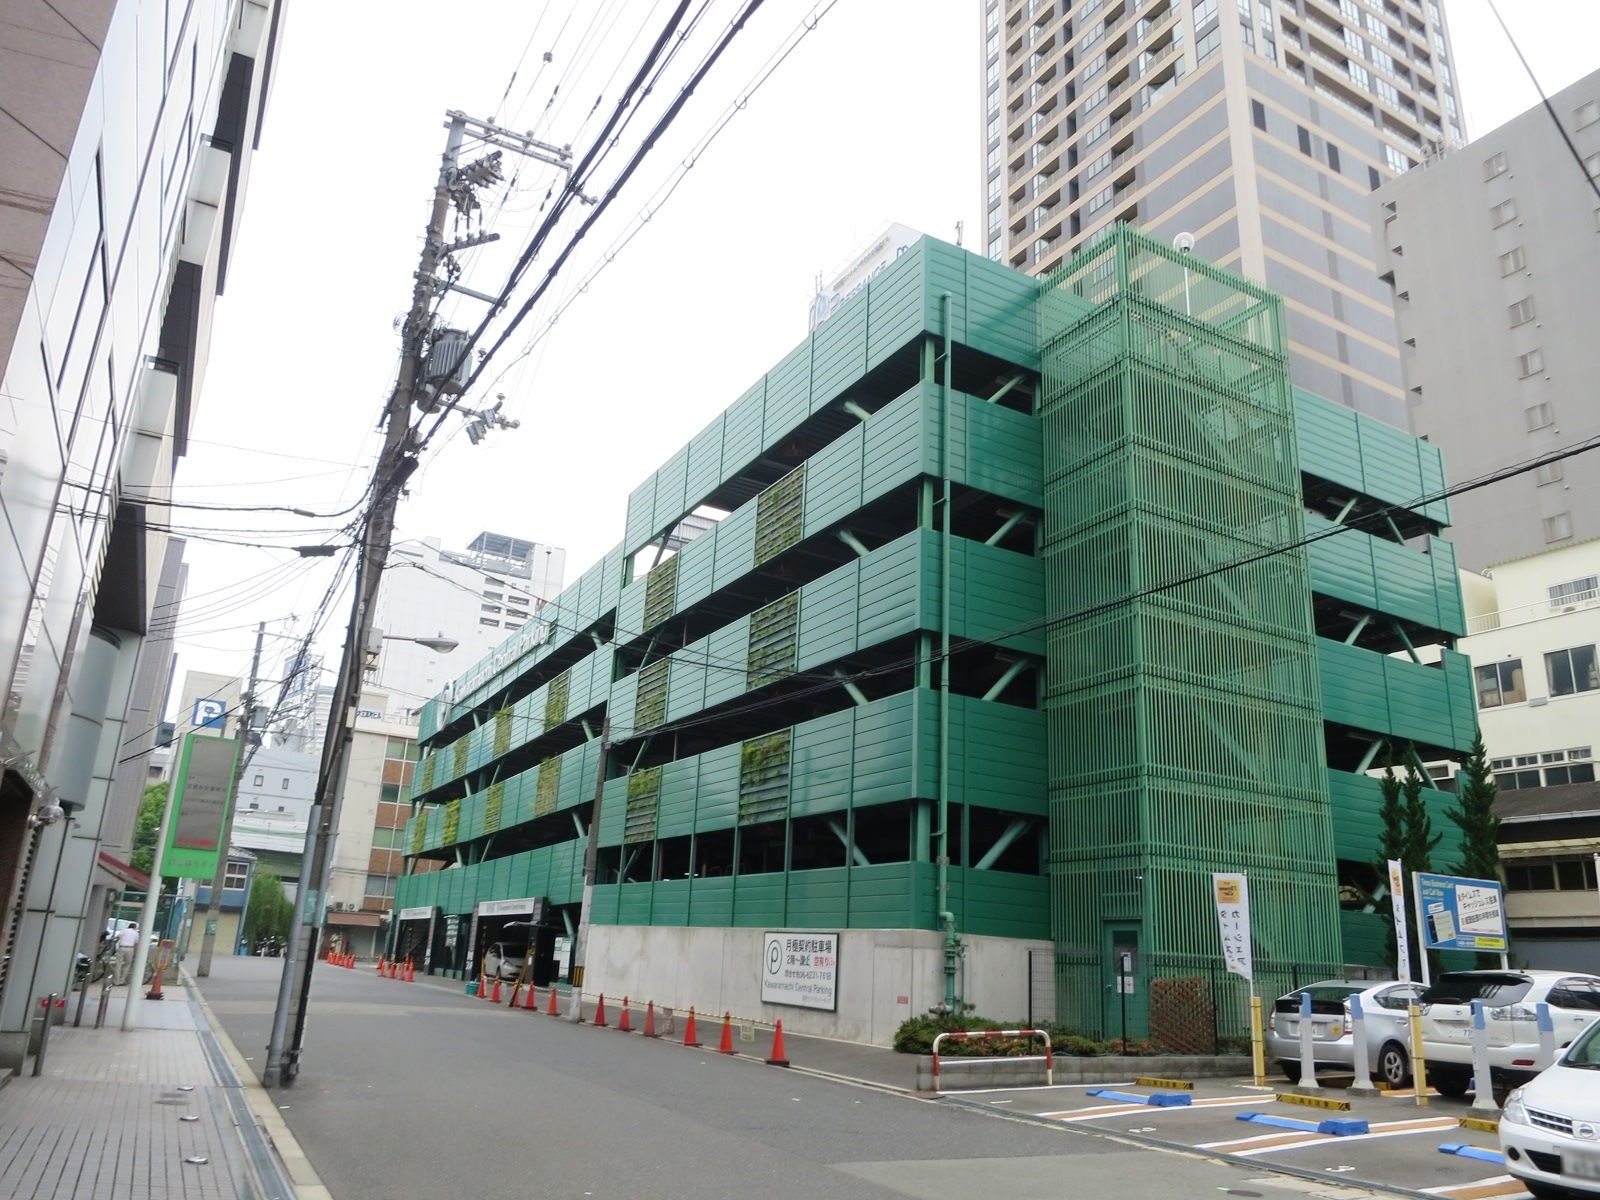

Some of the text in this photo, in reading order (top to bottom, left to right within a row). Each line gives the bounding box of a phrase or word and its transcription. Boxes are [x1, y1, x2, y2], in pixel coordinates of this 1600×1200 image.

[195, 700, 221, 725] P
[795, 982, 813, 993] Central
[814, 984, 832, 997] Parking
